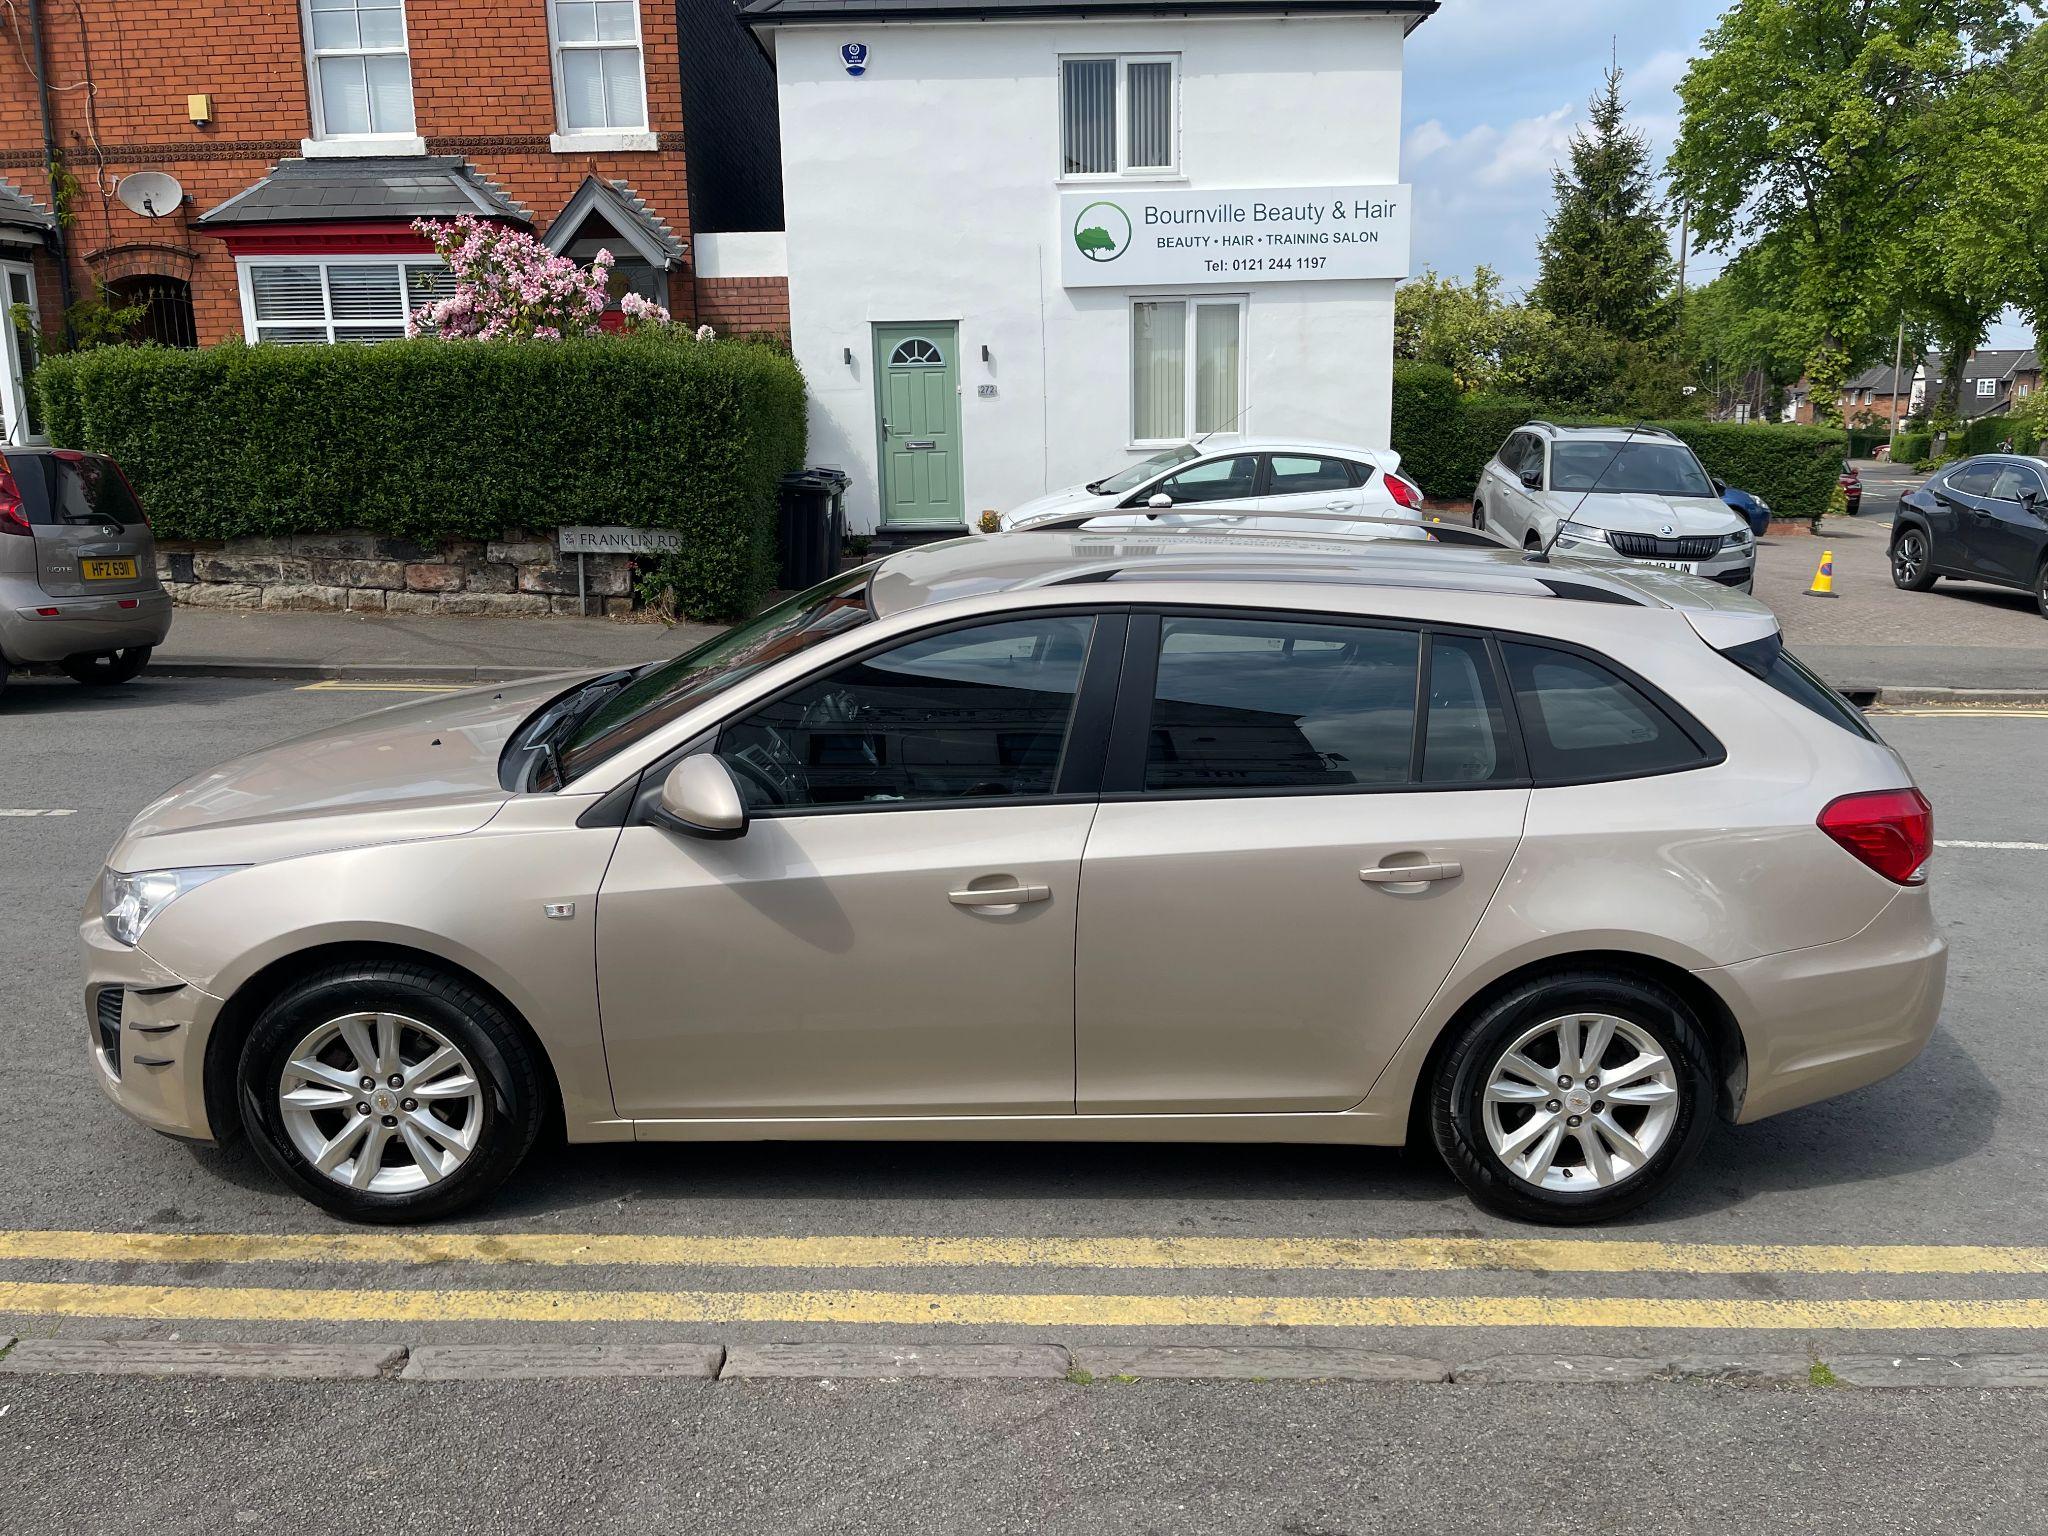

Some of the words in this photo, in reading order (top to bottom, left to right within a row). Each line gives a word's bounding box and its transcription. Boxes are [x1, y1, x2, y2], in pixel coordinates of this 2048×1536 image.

[1145, 203, 1246, 224] Bournville
[1253, 202, 1325, 224] Beauty
[1332, 200, 1346, 220] &
[1354, 199, 1397, 219] Hair
[1157, 236, 1210, 248] BEAUTY
[1222, 235, 1254, 247] HAIR
[1266, 232, 1329, 245] TRAINING
[1333, 231, 1379, 244] SALON
[1204, 259, 1228, 272] Tel:
[1232, 258, 1263, 271] 0121
[1268, 258, 1292, 270] 244
[1296, 257, 1327, 269] 1197
[980, 385, 995, 394] 272
[580, 533, 653, 547] FRANKLIN
[655, 535, 679, 547] RD
[92, 562, 111, 576] HFZ
[112, 562, 130, 576] 6911
